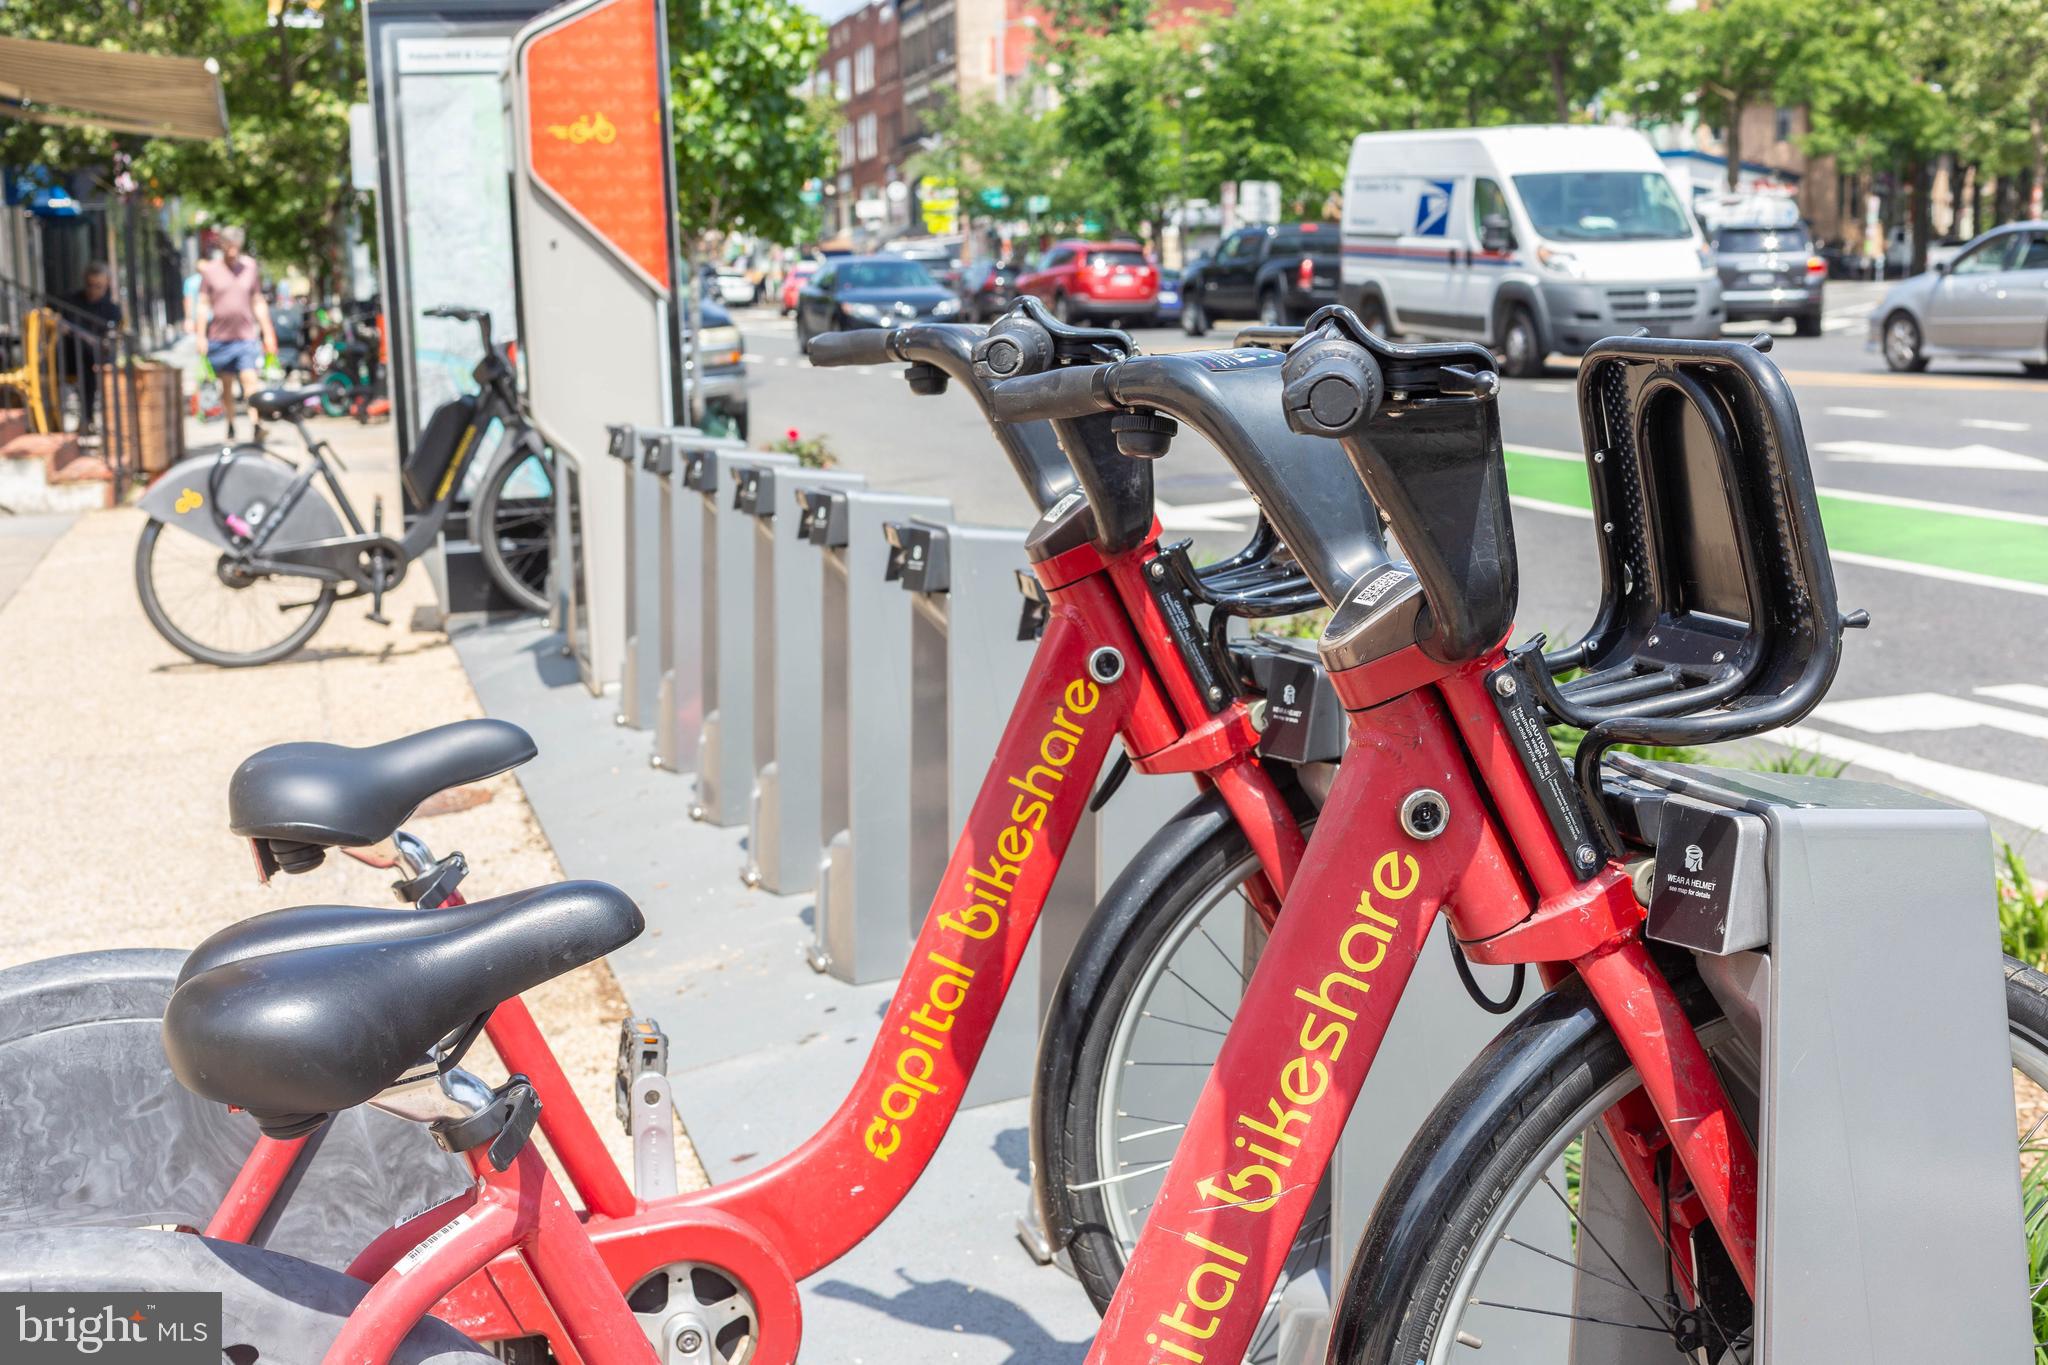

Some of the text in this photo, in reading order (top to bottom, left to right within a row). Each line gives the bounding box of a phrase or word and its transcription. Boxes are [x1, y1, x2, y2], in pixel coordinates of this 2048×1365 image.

[1511, 710, 1519, 722] Not
[1518, 726, 1527, 740] child
[1525, 740, 1537, 762] carrying
[1534, 762, 1545, 779] device
[1517, 707, 1550, 775] Maximum weight 10kg
[1528, 718, 1549, 757] CAUTION
[1667, 874, 1685, 885] WEAR
[1691, 879, 1716, 892] HELMET
[1695, 890, 1711, 899] details
[864, 678, 1100, 1162] capital bikeshare
[1196, 850, 1420, 1212] bikeshare
[1418, 1185, 1503, 1354] MARATHON PLUS
